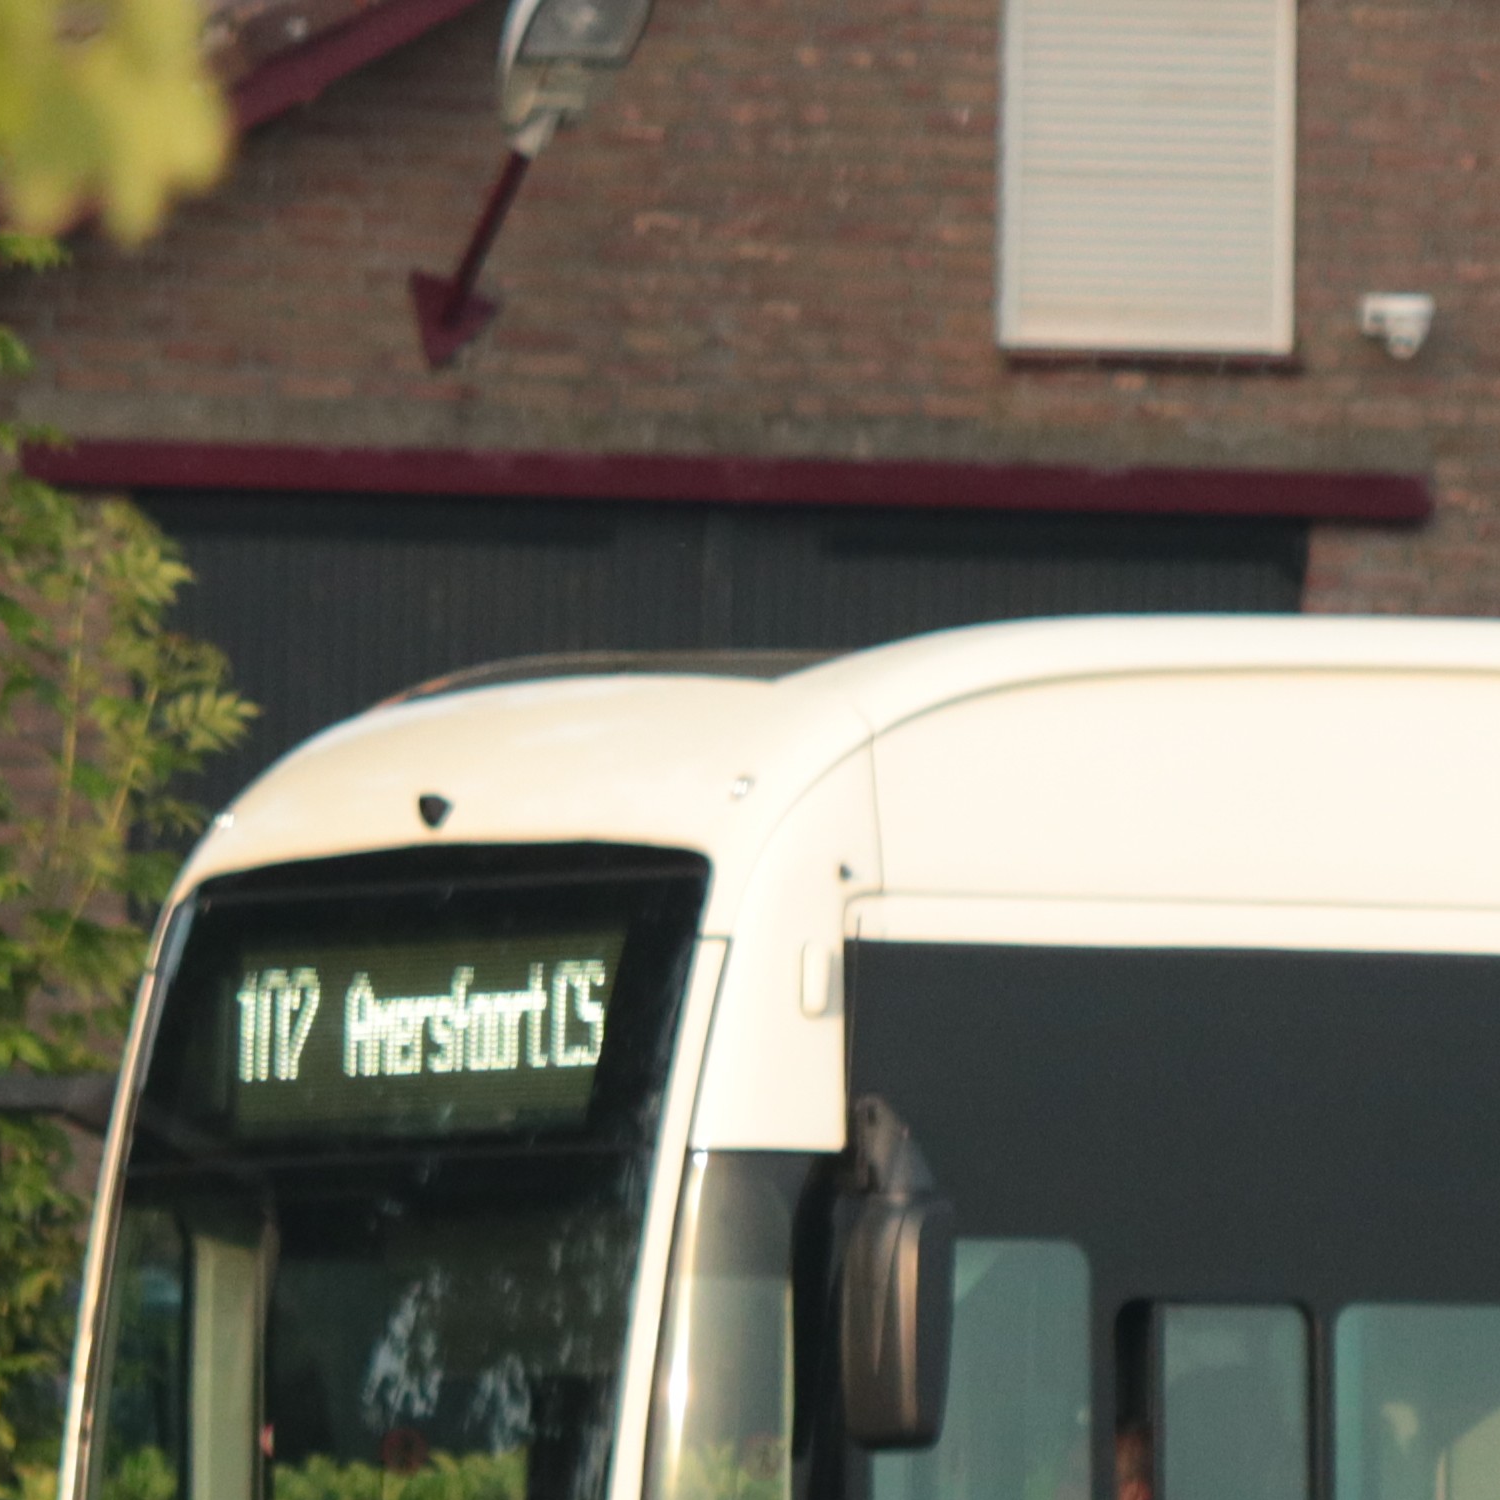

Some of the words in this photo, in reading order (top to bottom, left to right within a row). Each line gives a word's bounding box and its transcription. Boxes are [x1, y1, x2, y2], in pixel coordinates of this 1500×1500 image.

[237, 967, 320, 1083] 102
[343, 962, 548, 1078] Amersfoort
[551, 959, 606, 1068] CS
